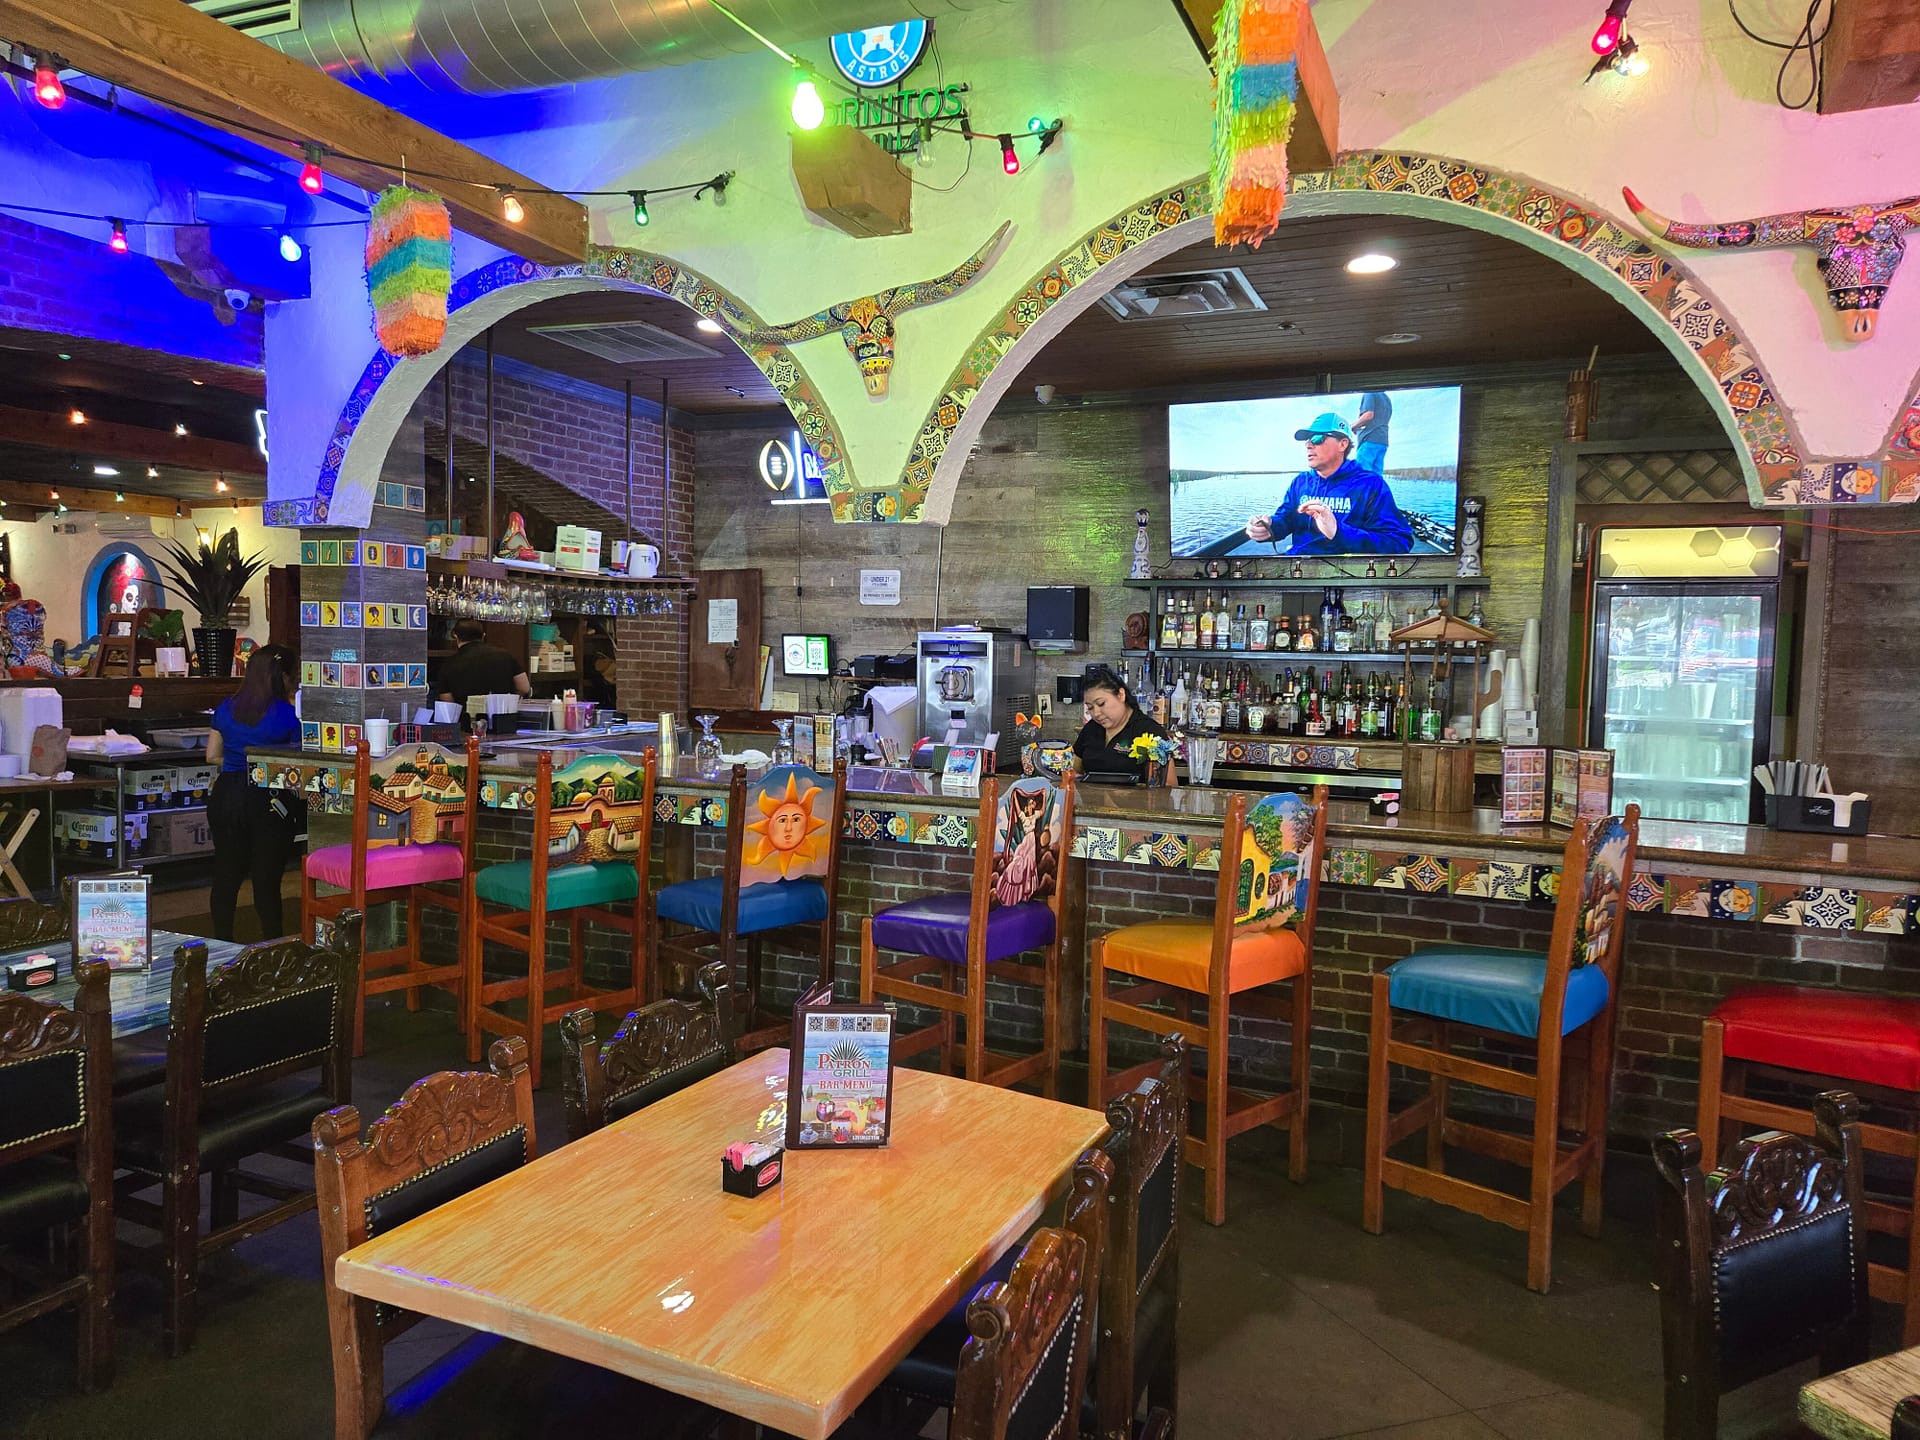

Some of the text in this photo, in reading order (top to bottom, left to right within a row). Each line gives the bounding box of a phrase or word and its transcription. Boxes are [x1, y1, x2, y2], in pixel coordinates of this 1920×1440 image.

[846, 51, 909, 80] ASTROS
[72, 821, 98, 833] Corona
[833, 1069, 870, 1077] GRILL
[819, 1080, 872, 1089] BAR MENU
